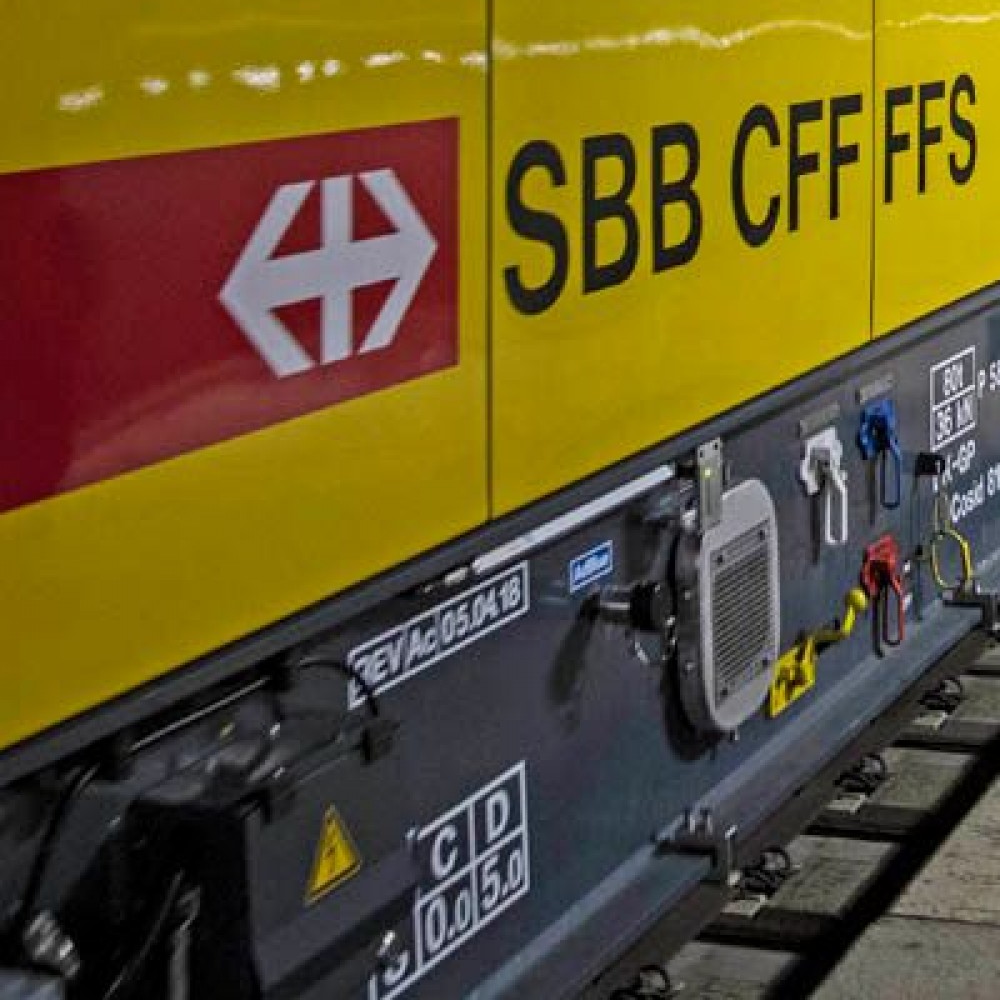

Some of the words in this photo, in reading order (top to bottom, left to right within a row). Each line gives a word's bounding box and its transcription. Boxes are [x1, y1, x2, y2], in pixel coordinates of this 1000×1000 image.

[503, 122, 703, 317] SBB
[731, 92, 863, 249] CFF
[884, 73, 977, 204] FFS
[441, 574, 521, 643] 05.04.18
[430, 824, 458, 880] C
[485, 789, 511, 843] D
[424, 889, 471, 952] 0.0
[481, 849, 522, 910] 5.0
